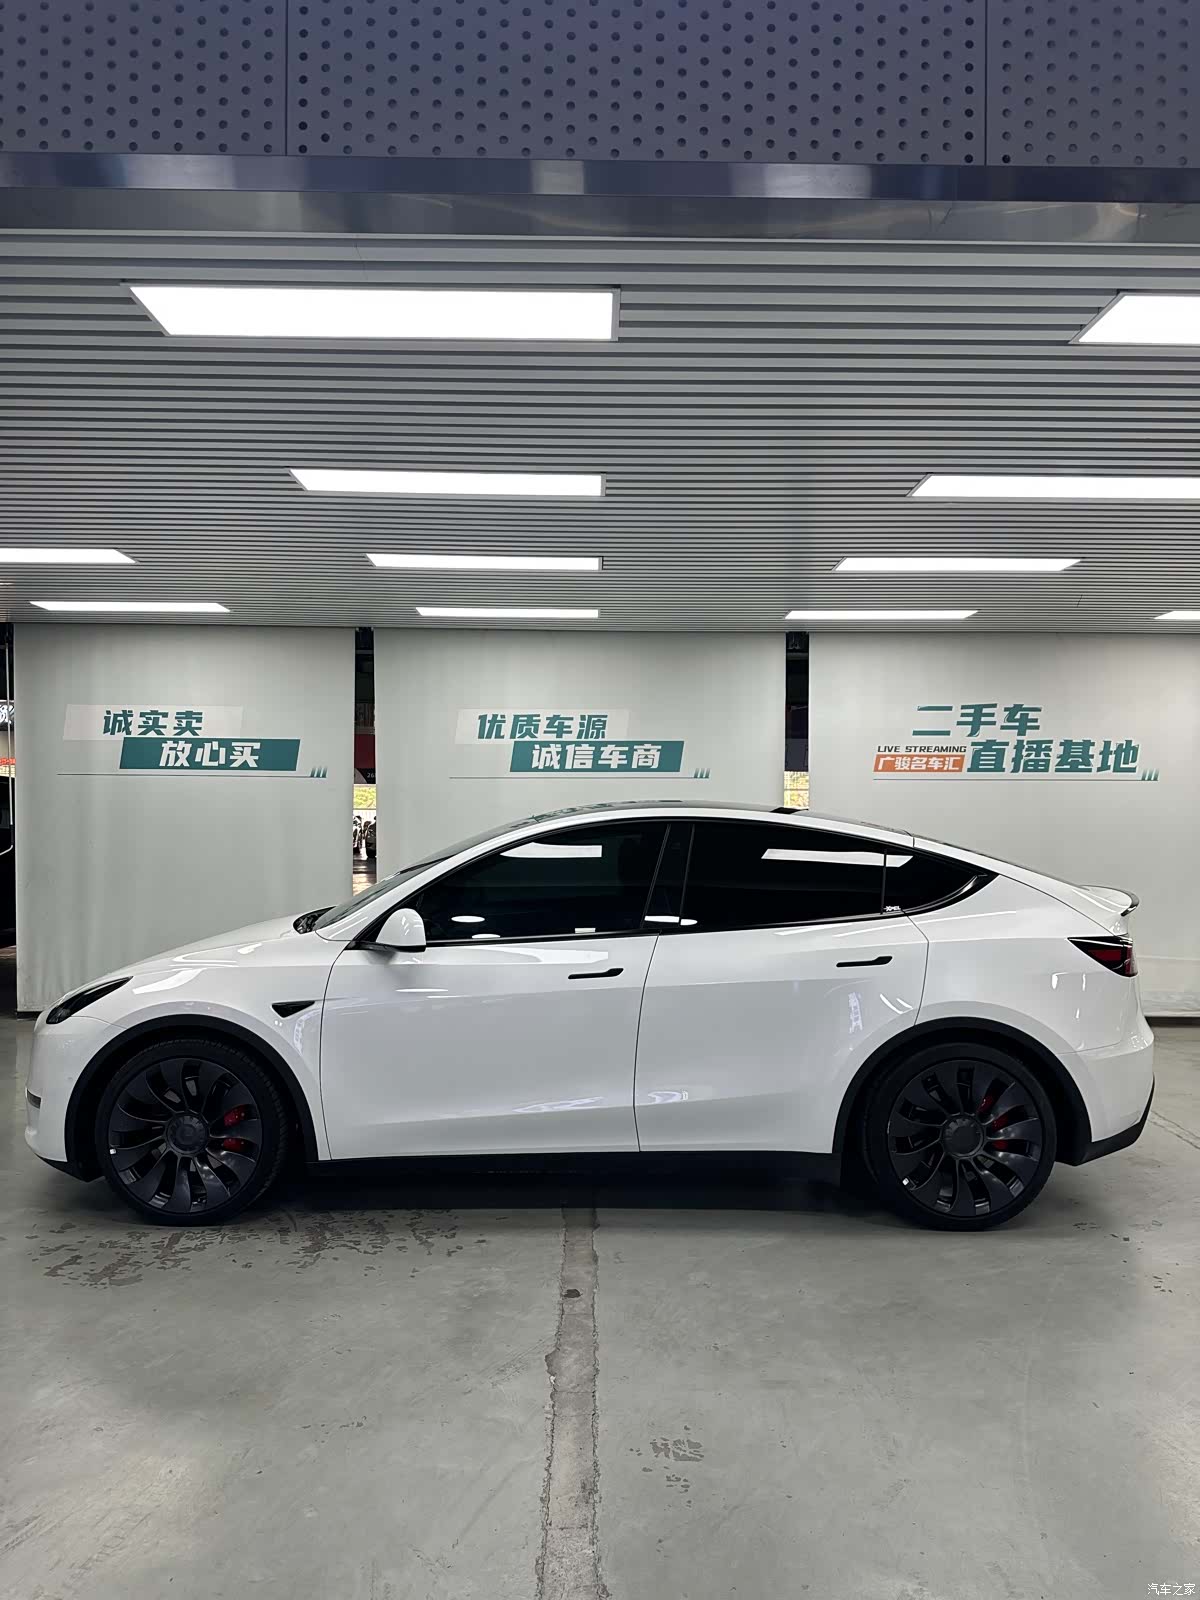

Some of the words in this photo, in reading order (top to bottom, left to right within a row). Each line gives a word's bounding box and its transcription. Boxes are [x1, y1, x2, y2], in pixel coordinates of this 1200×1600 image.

[103, 710, 203, 736] 诚实卖
[477, 714, 608, 739] 优质车源
[912, 703, 1042, 737] 二手车
[159, 740, 261, 767] 放心买
[531, 744, 662, 769] 诚信车商
[877, 745, 901, 753] LIVE
[904, 745, 967, 753] STREAMING
[966, 739, 1140, 773] 直播基地
[877, 756, 961, 771] 广骏名车汇
